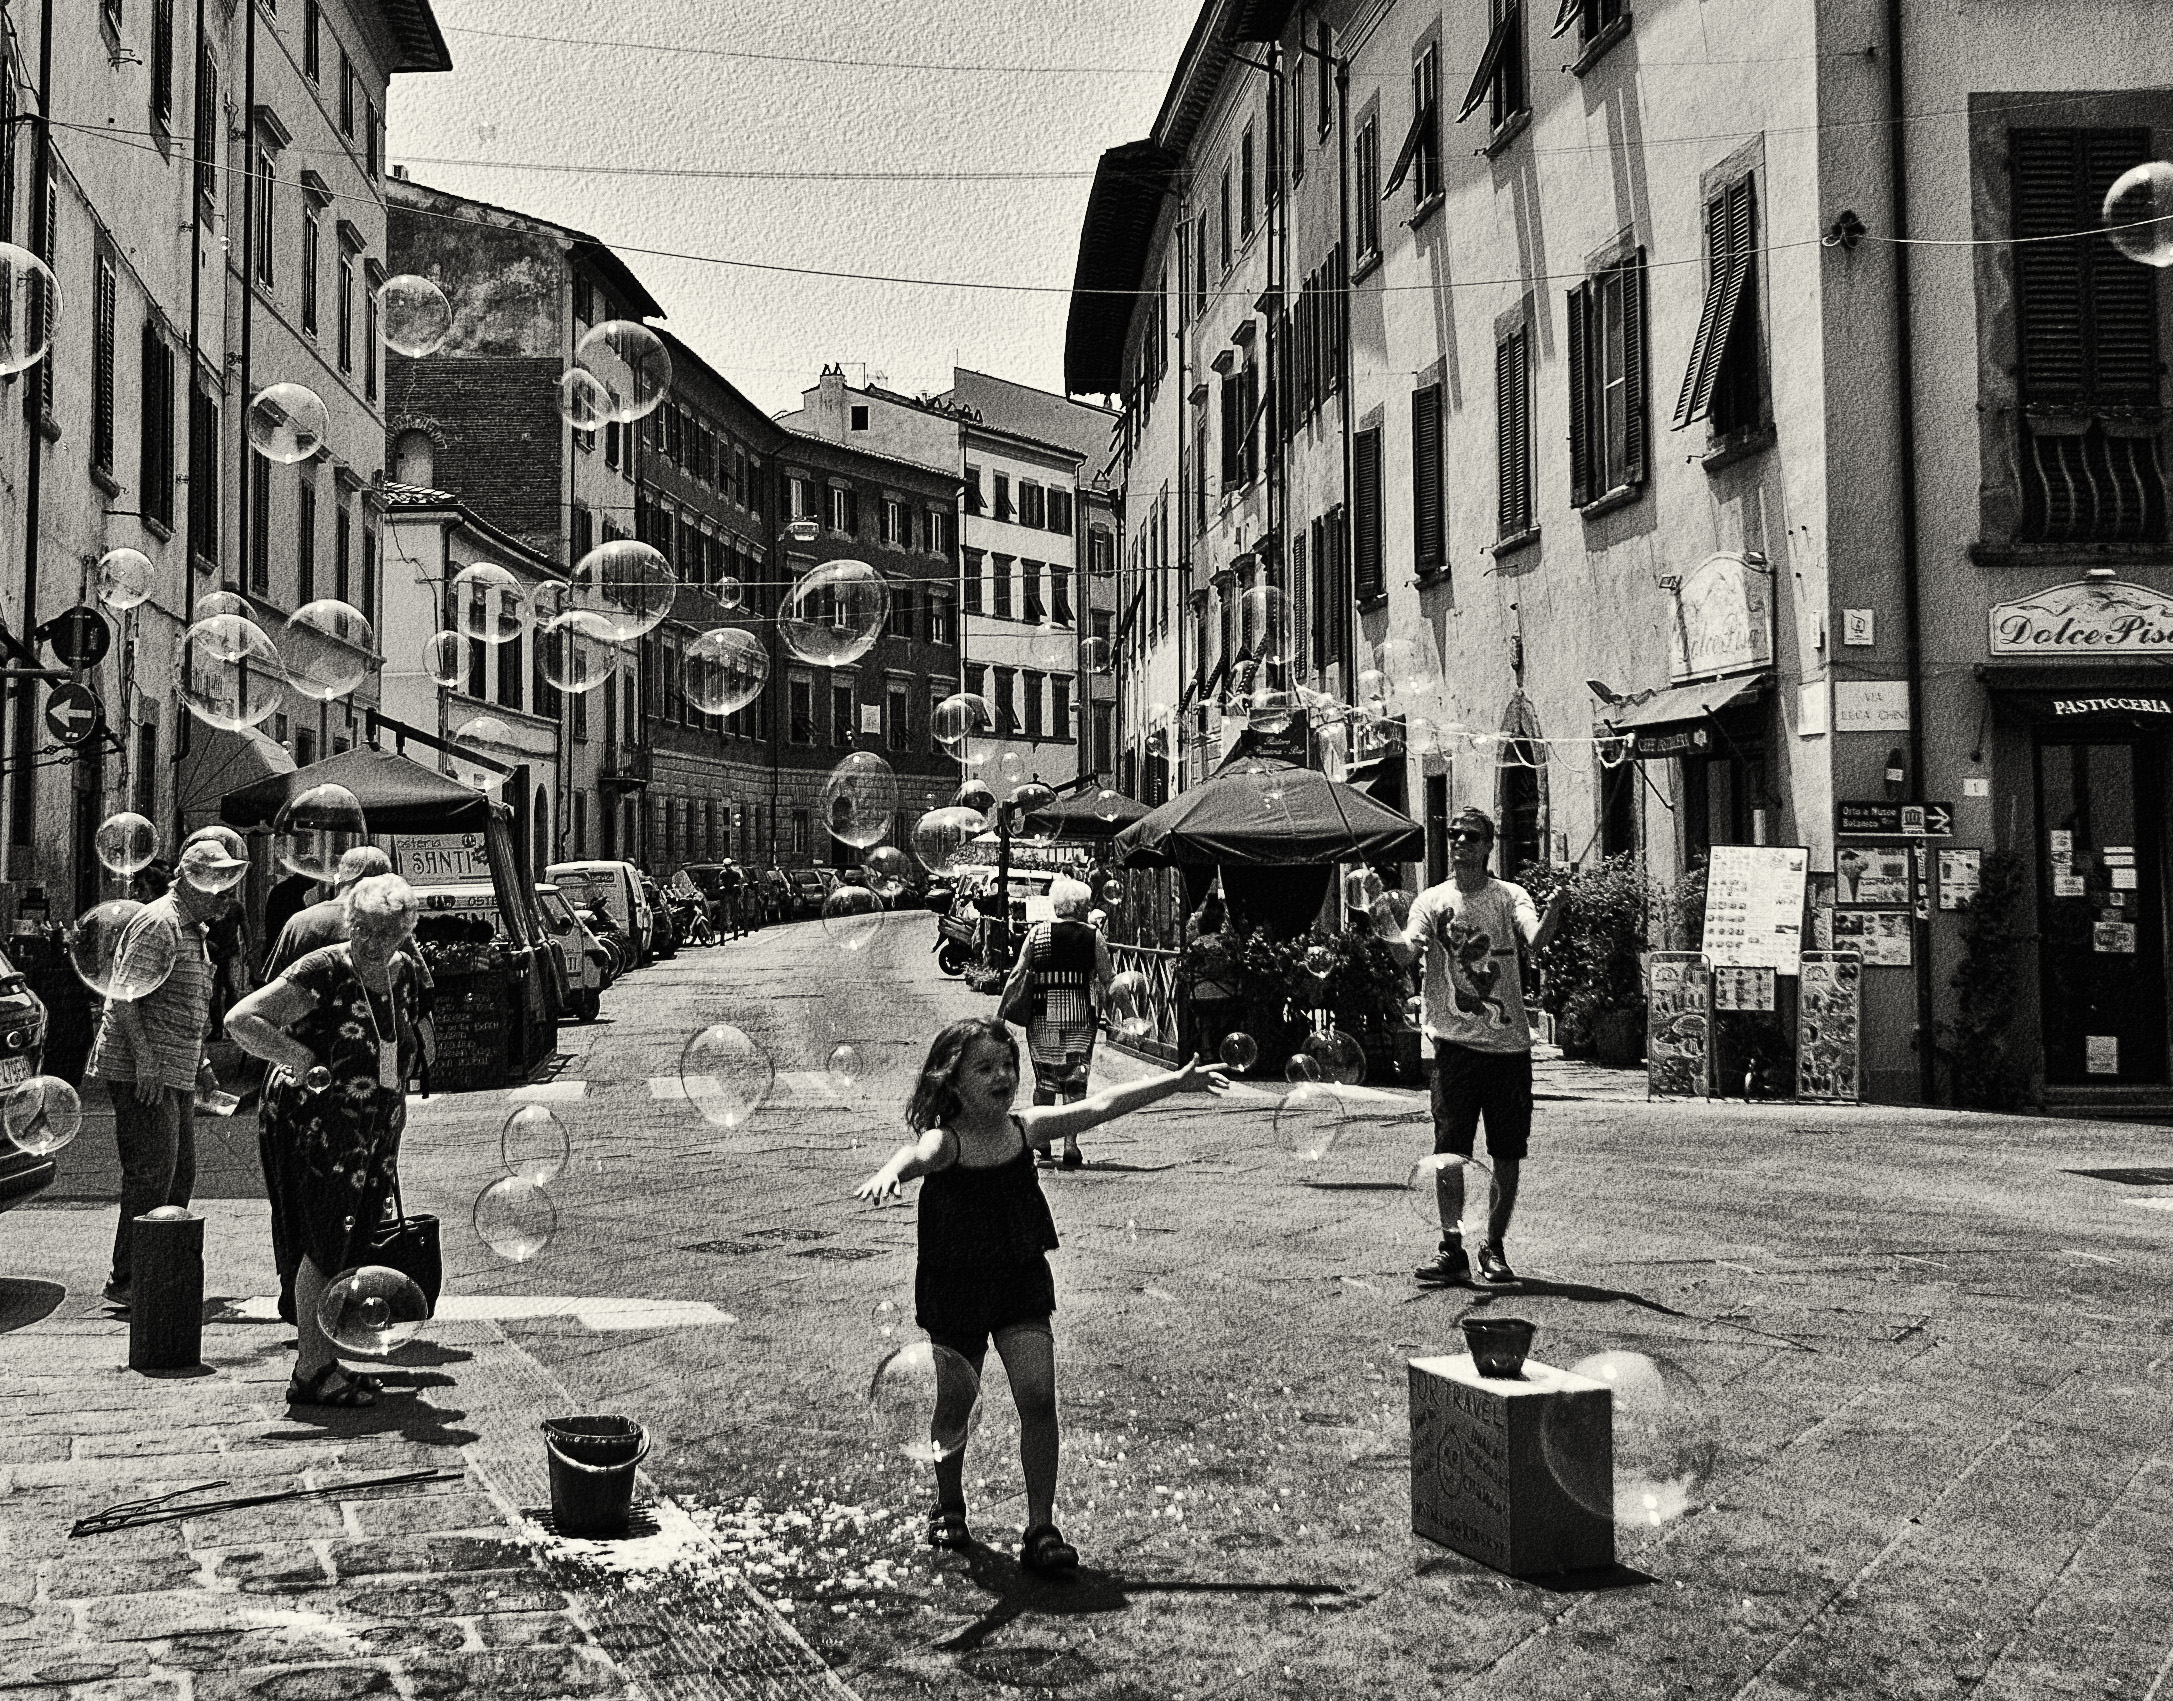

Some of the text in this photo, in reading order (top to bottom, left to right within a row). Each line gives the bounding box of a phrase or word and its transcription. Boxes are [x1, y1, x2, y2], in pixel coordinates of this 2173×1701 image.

[2000, 615, 2102, 644] Dolce
[1864, 692, 1883, 701] VIA
[2053, 698, 2172, 715] PASTICCERIA
[412, 850, 472, 874] SANTI
[1441, 1381, 1504, 1428] TRAVEL
